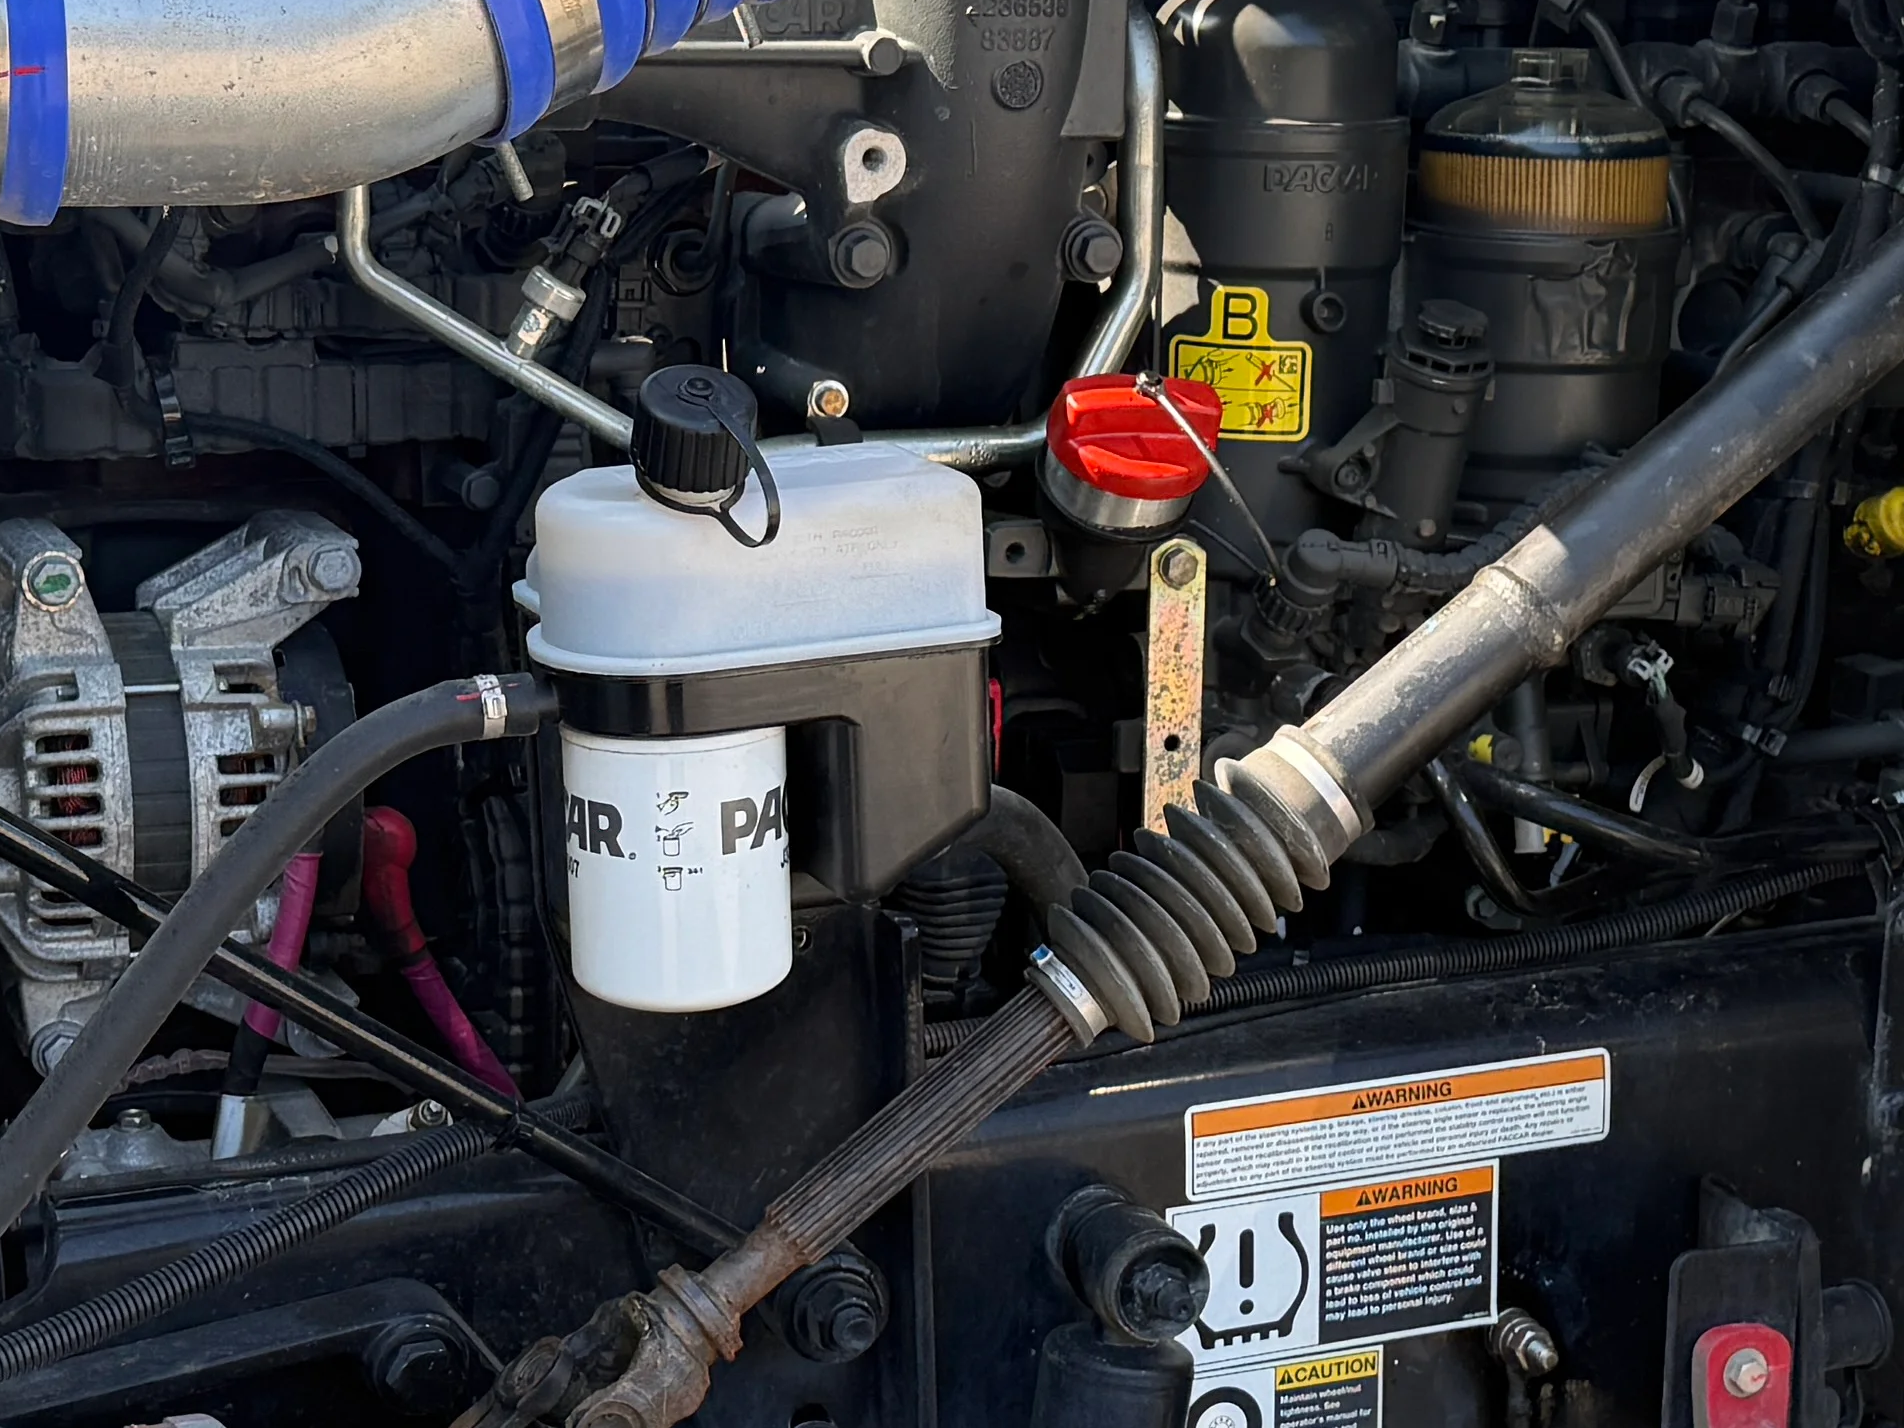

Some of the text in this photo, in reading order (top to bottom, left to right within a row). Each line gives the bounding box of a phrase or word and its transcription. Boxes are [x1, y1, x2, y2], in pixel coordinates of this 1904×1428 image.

[1222, 291, 1259, 342] B
[566, 784, 789, 859] AR PA
[1366, 1080, 1452, 1108] WARNING
[1372, 1176, 1458, 1204] WARNING
[1325, 1235, 1345, 1248] part
[1346, 1233, 1362, 1243] no.
[1406, 1223, 1418, 1236] by
[1420, 1220, 1436, 1232] the
[1437, 1214, 1474, 1231] original
[1326, 1221, 1345, 1235] Use
[1346, 1218, 1367, 1233] only
[1369, 1215, 1385, 1228] the
[1387, 1210, 1414, 1225] wheel
[1416, 1206, 1446, 1221] brand,
[1448, 1202, 1468, 1215] size
[1325, 1226, 1483, 1260] equipment manufacturer. Use of a
[1325, 1237, 1486, 1272] different wheel brand or size could
[1325, 1271, 1354, 1285] cause
[1356, 1266, 1381, 1279] valve
[1383, 1262, 1407, 1275] stem
[1408, 1261, 1418, 1271] to
[1461, 1250, 1481, 1262] with
[1325, 1263, 1474, 1297] a brake component which could
[1325, 1274, 1482, 1309] lead to loss of vehicle control and
[1325, 1309, 1346, 1323] may
[1347, 1305, 1368, 1318] lead
[1369, 1303, 1380, 1314] to
[1381, 1296, 1423, 1314] personal
[1294, 1355, 1376, 1383] CAUTION
[1359, 1405, 1371, 1417] for
